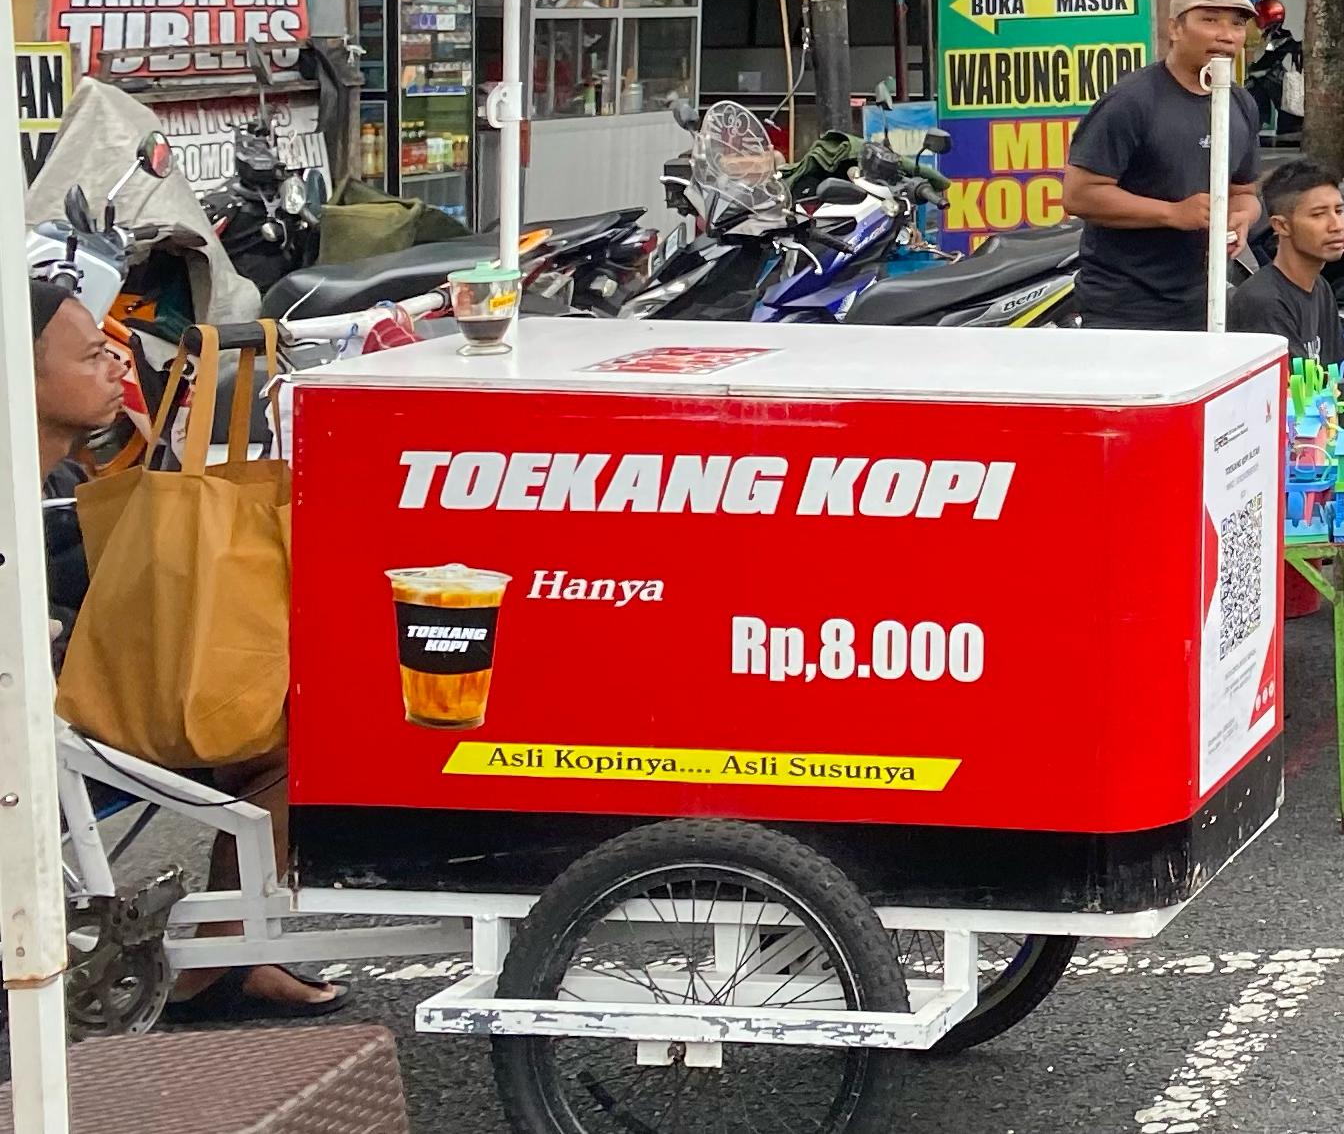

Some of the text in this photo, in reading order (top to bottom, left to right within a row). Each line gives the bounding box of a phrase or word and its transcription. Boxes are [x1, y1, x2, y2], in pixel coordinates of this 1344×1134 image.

[17, 54, 63, 120] AN
[948, 49, 1071, 107] WARUNG
[990, 121, 1078, 172] MI
[946, 178, 1066, 230] KOC
[399, 450, 1017, 520] TOEKANG KOPI
[526, 569, 665, 608] Hanya
[407, 625, 488, 641] TOEKANG
[424, 639, 470, 653] KOPI
[732, 615, 985, 683] Rp,8.000
[487, 747, 544, 769] Asli
[721, 755, 779, 776] Asli
[788, 757, 916, 783] Susunya
